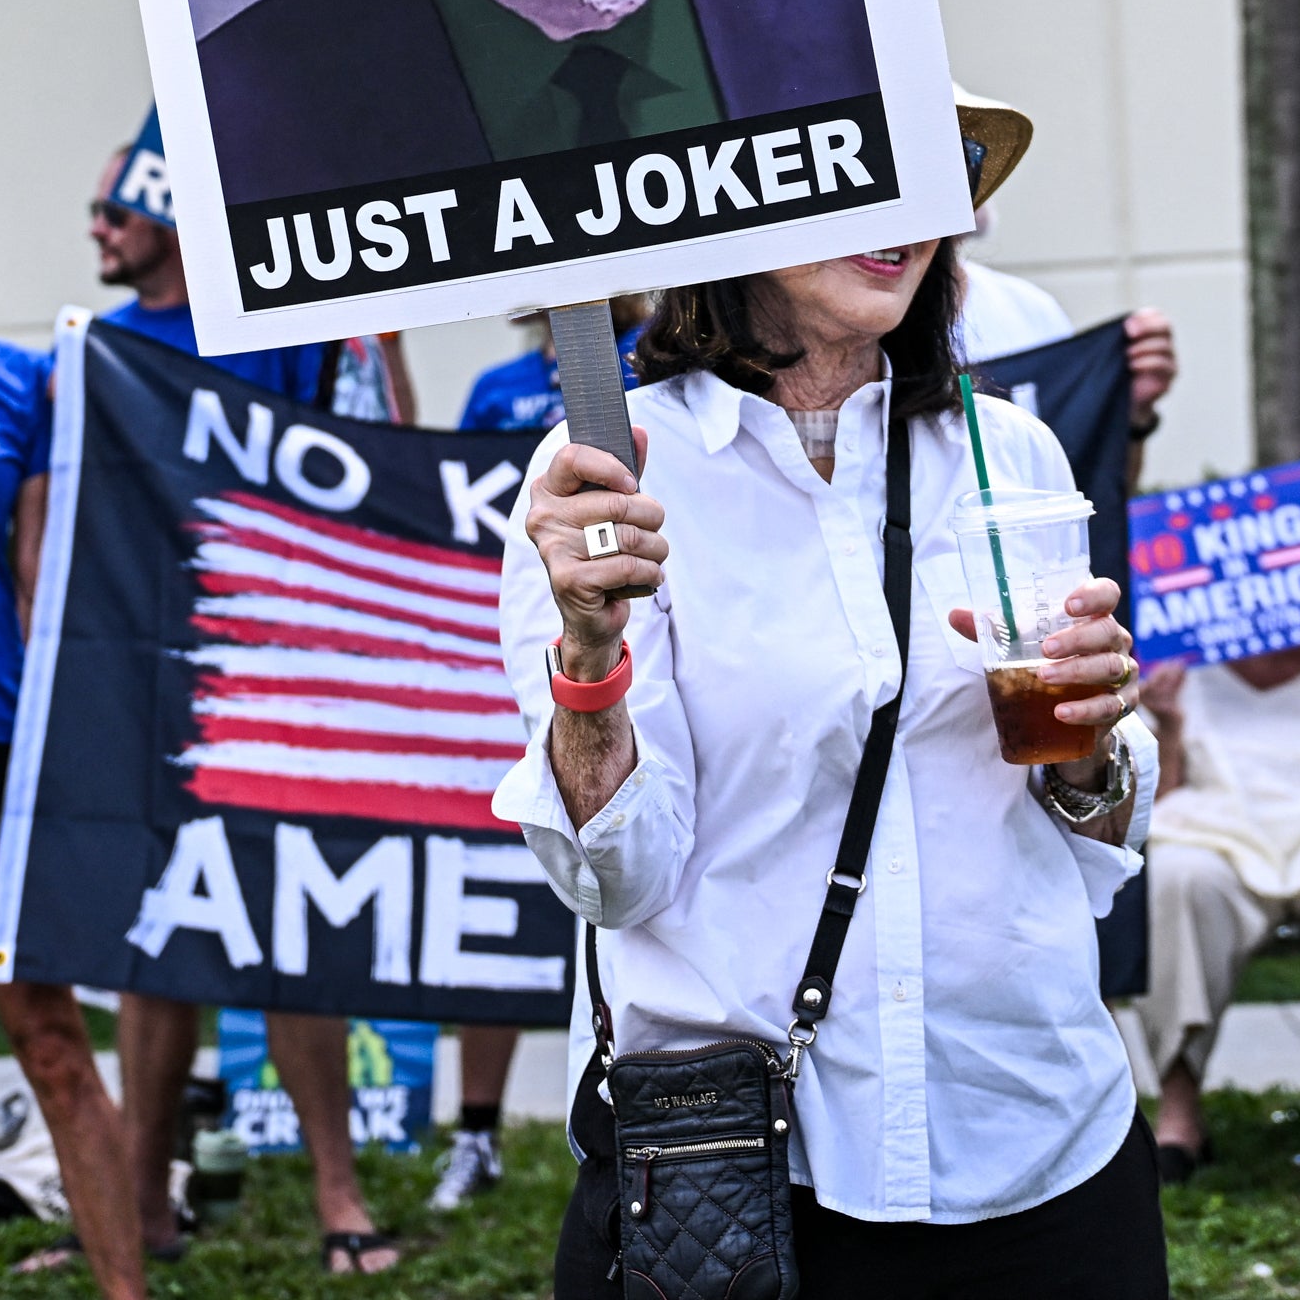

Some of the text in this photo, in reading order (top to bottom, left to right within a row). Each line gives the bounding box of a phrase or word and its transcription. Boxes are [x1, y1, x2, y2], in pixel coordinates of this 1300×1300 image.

[119, 148, 175, 220] R
[249, 118, 876, 291] JUST A JOKER
[181, 386, 372, 513] NO
[125, 814, 568, 993] AME
